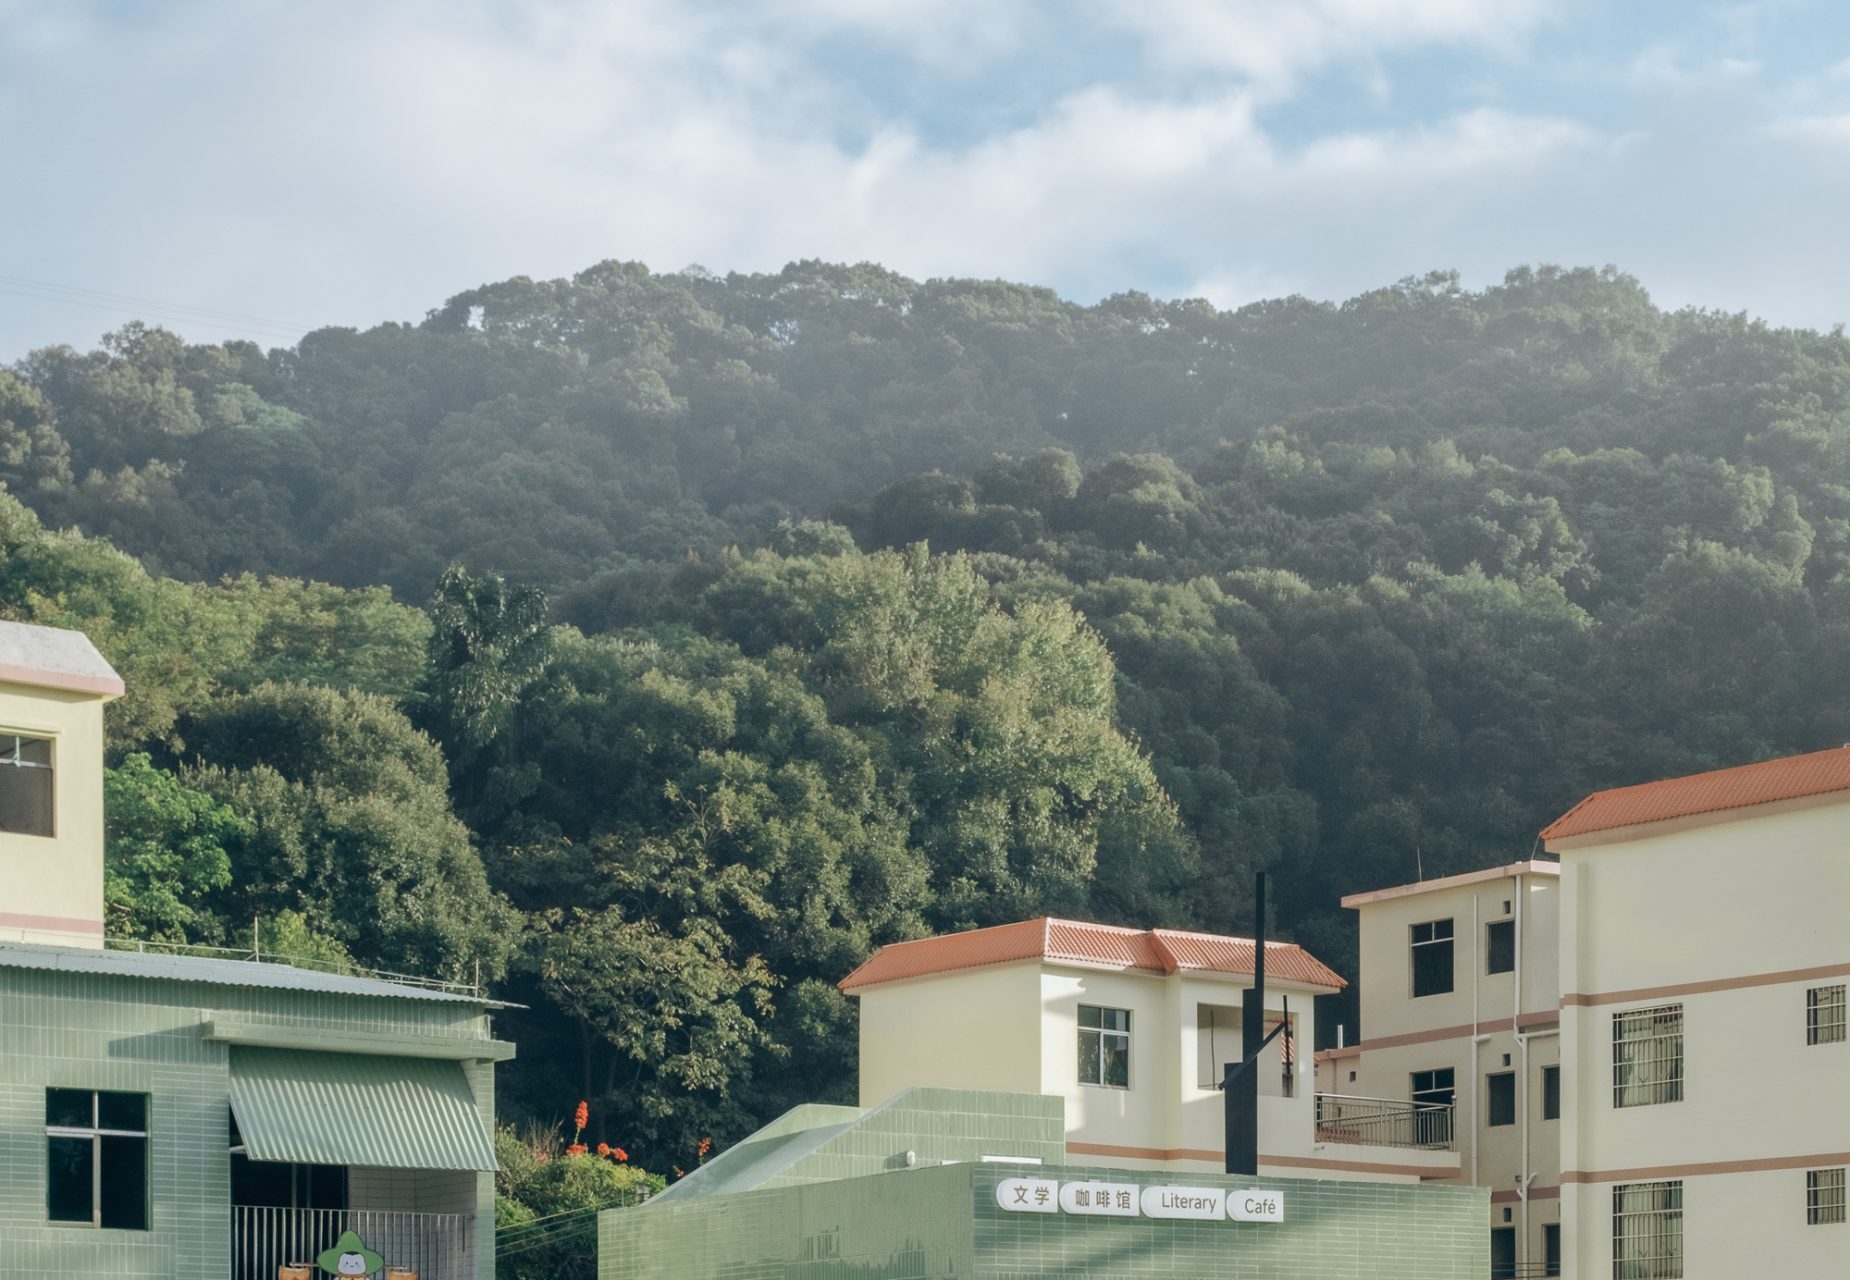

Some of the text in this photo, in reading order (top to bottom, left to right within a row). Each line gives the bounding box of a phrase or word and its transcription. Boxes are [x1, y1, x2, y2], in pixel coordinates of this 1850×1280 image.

[1013, 1185, 1131, 1210] 文学 咖啡馆
[1161, 1193, 1276, 1216] Literary Café
